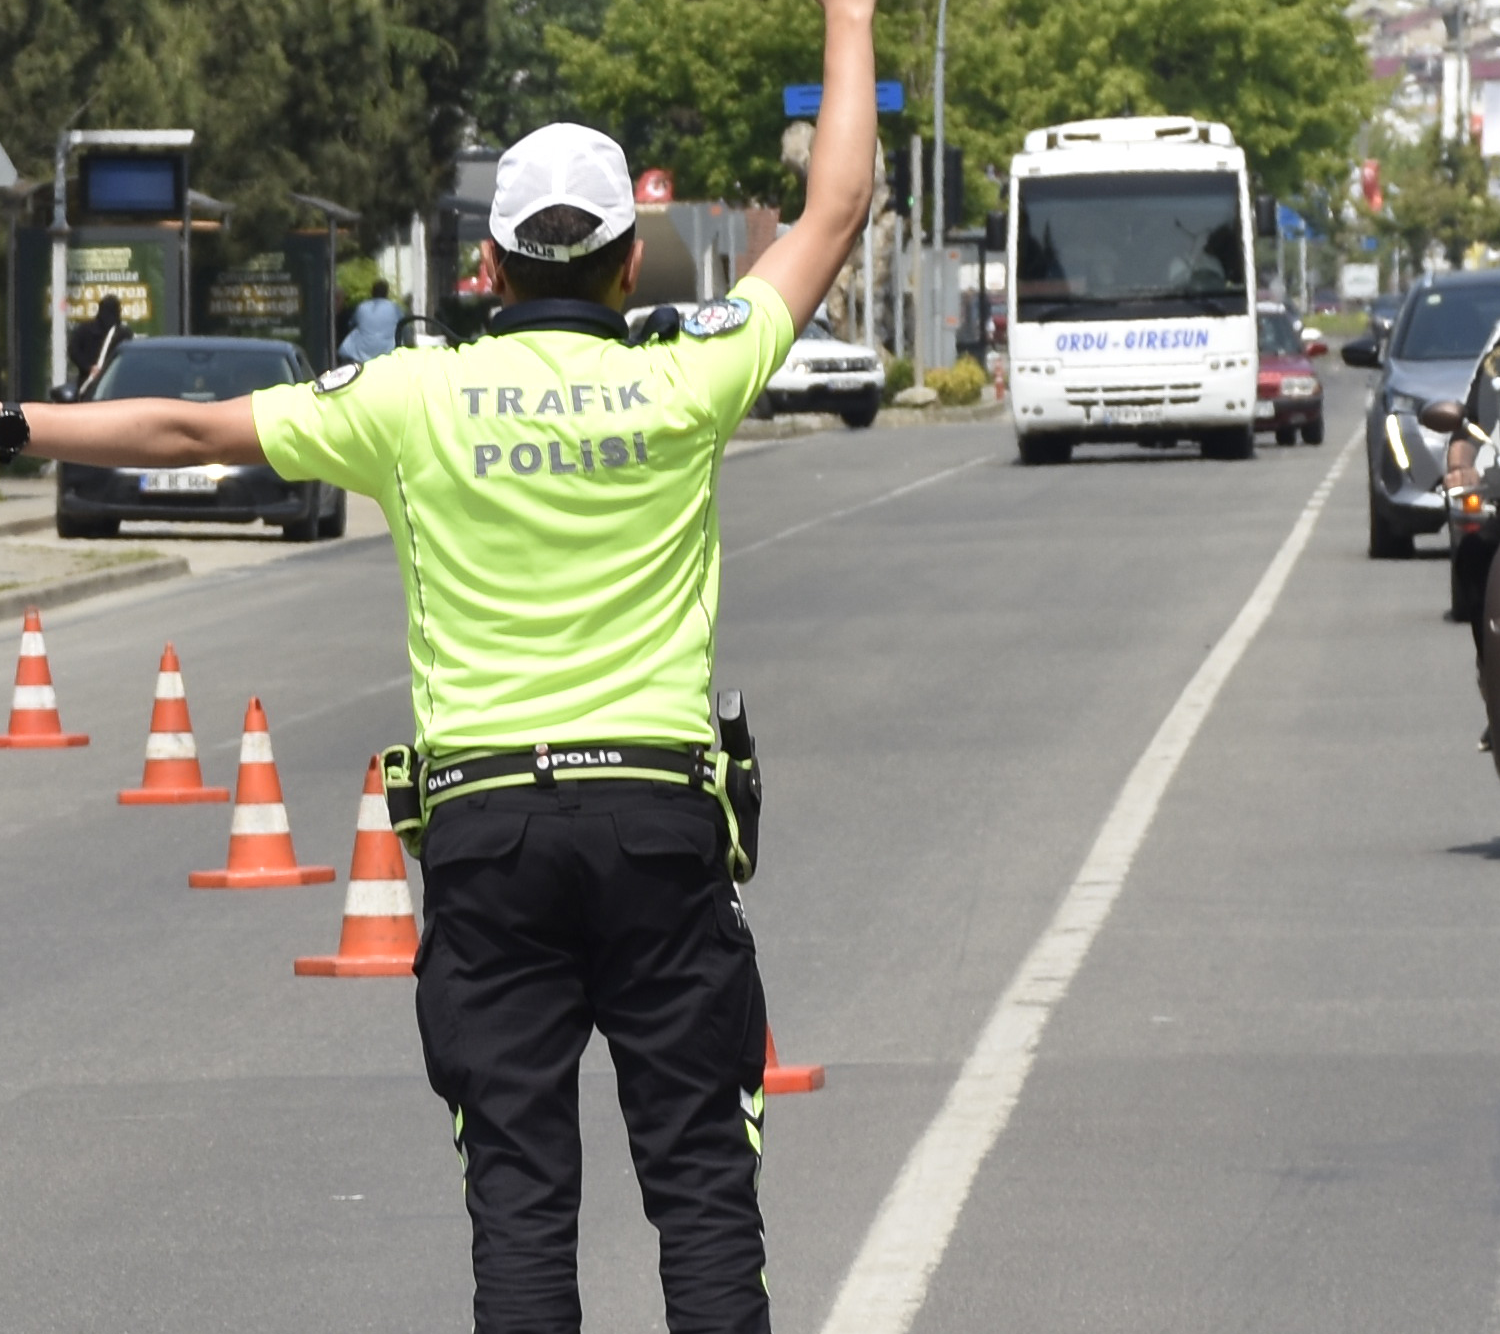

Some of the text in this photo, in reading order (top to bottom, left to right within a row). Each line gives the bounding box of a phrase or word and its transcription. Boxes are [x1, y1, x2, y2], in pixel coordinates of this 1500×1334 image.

[1056, 332, 1109, 352] ORDU
[460, 380, 652, 417] TRAFİK
[473, 431, 648, 478] POLİSİ
